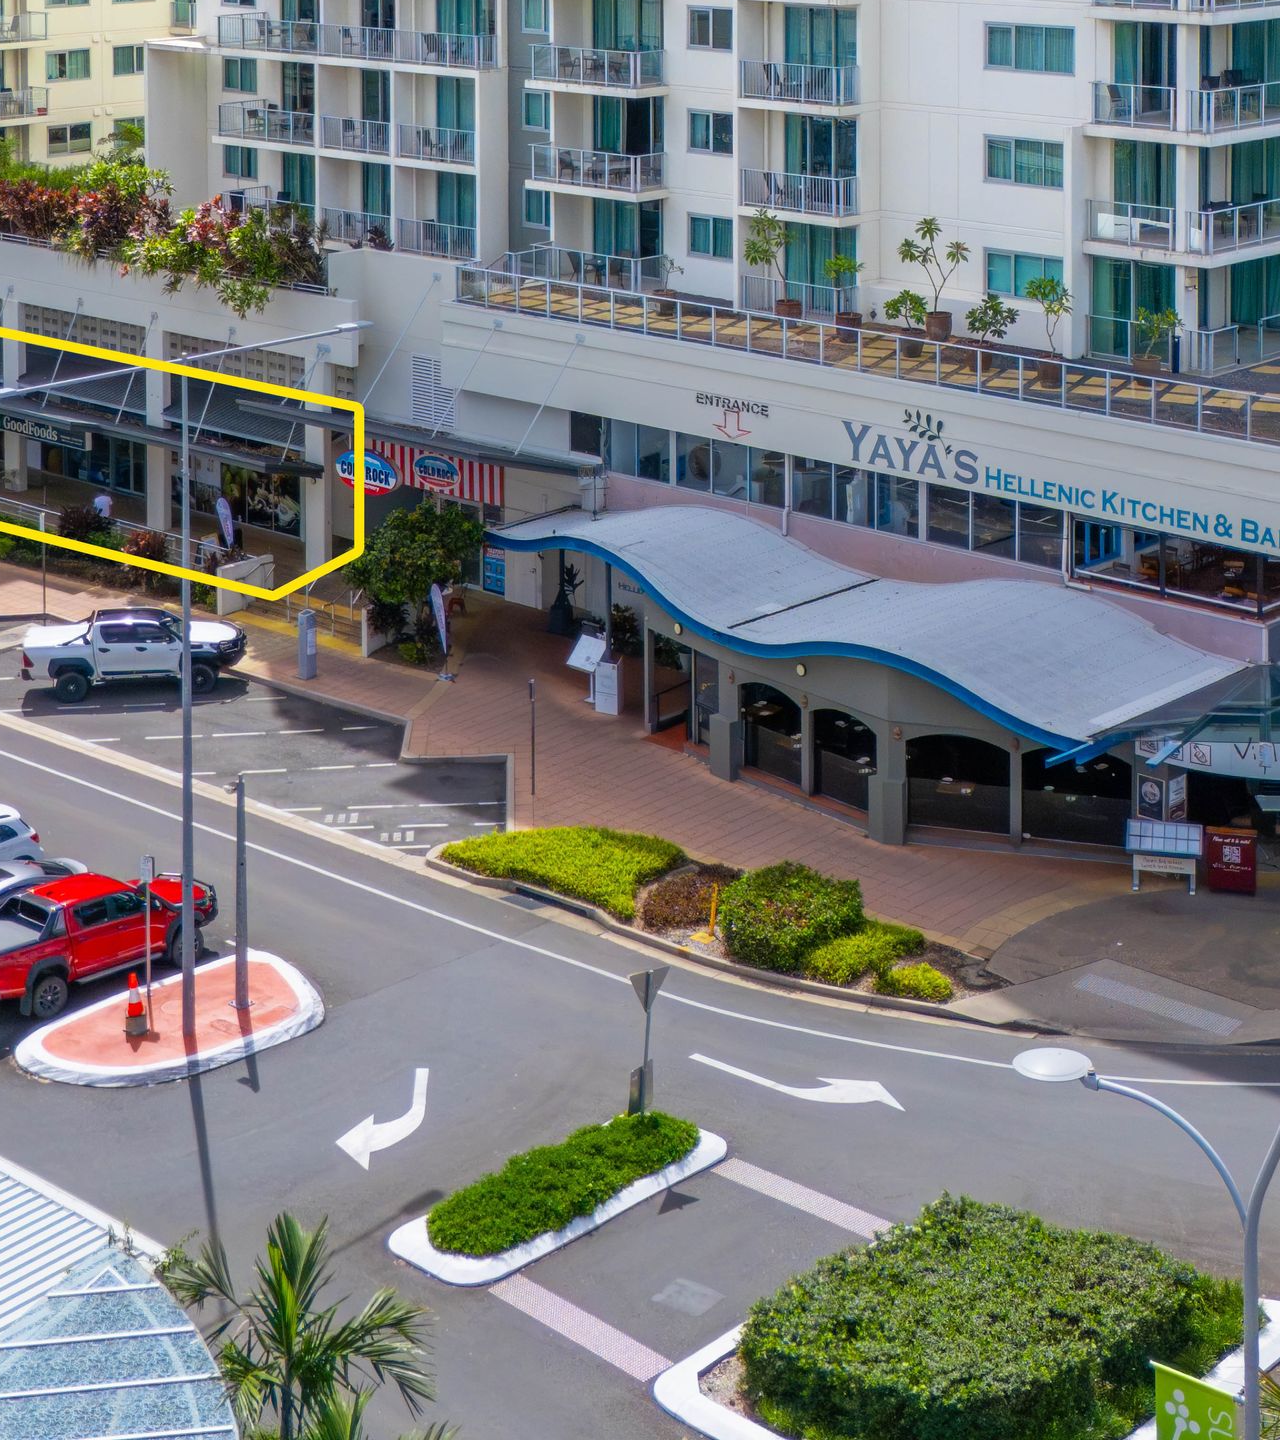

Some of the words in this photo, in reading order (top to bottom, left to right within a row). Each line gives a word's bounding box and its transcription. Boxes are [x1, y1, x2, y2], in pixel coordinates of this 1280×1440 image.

[696, 392, 769, 418] ENTRANCE
[3, 416, 58, 441] GoodFoods
[365, 466, 390, 486] ROCK
[419, 464, 436, 477] COLD
[436, 467, 455, 482] ROCK
[841, 420, 979, 485] YAYA'S
[984, 466, 1095, 509] HELLENIC
[1101, 489, 1209, 534] KITCHEN
[1213, 513, 1233, 539] &
